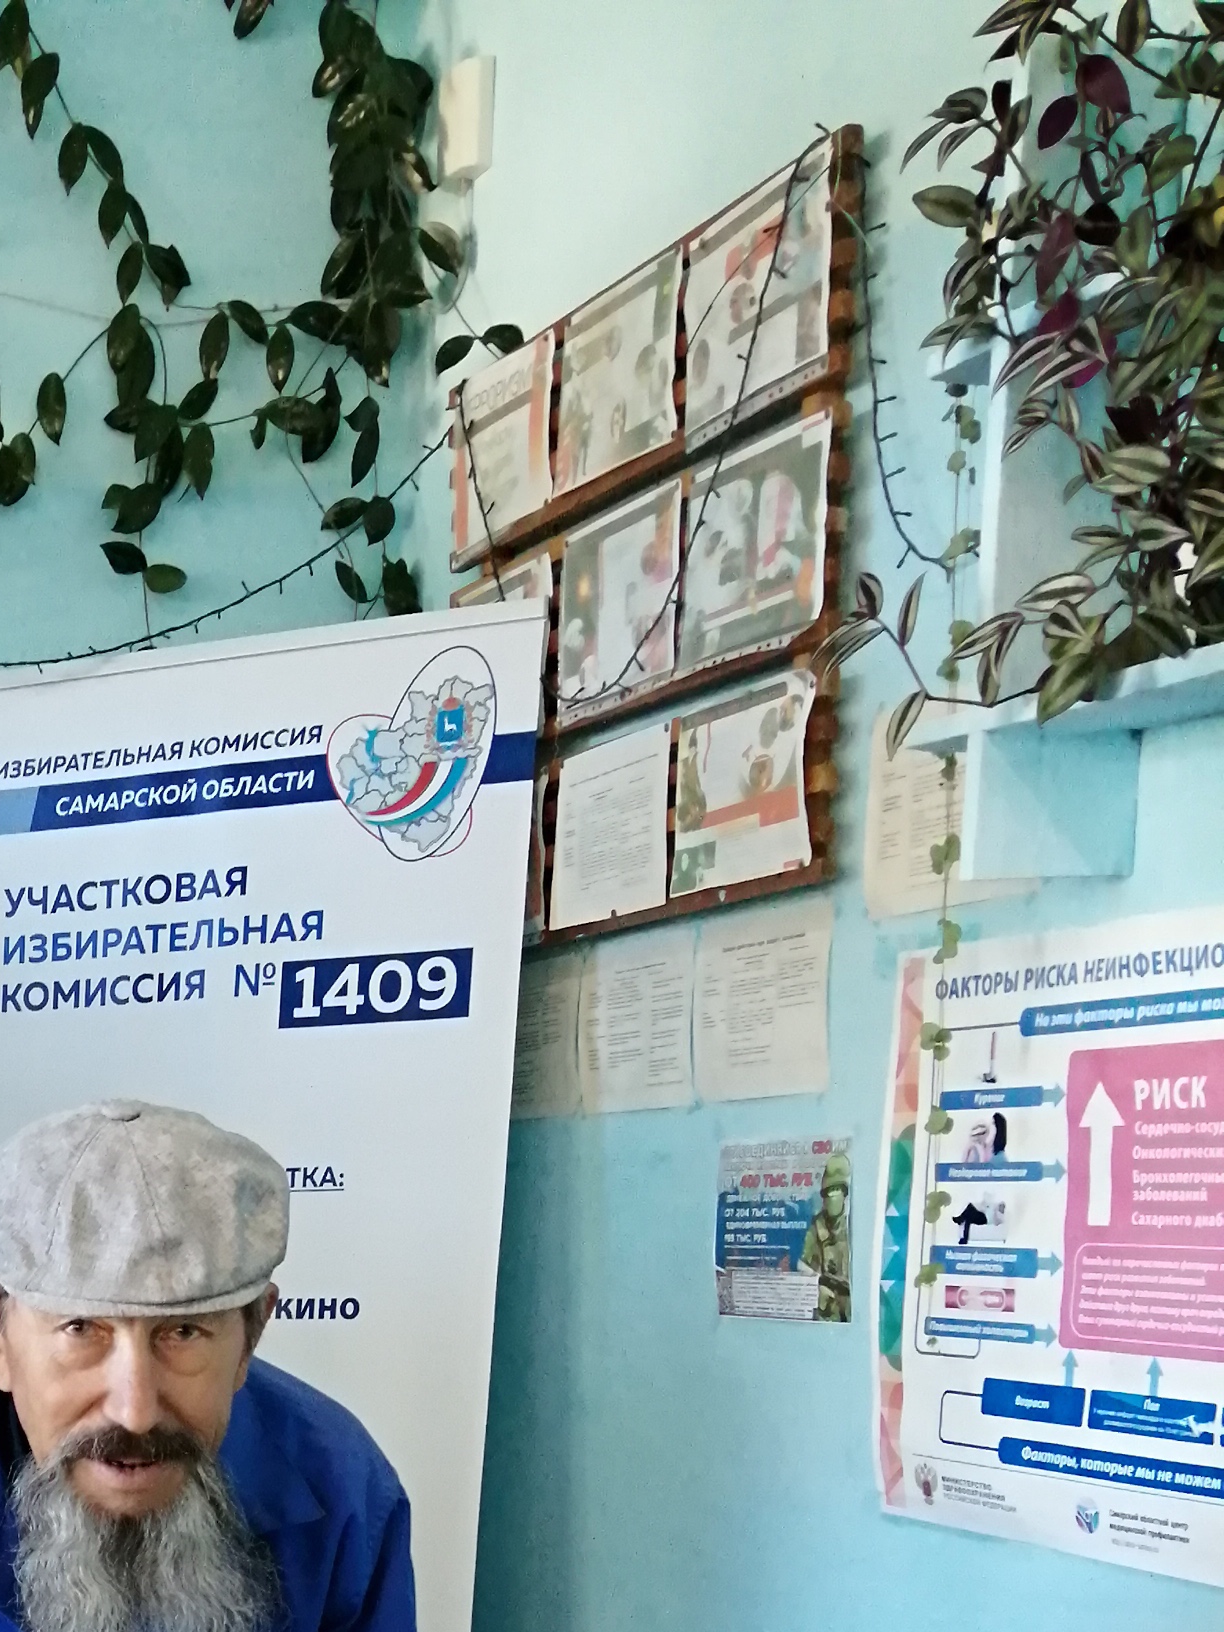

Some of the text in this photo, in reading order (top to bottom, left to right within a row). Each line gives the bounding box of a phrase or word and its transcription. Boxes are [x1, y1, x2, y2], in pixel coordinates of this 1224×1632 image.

[188, 724, 323, 759] КОМИССИЯ
[55, 769, 316, 817] САМАРСКОЙ ОБЛАСТИ
[4, 866, 248, 917] УЧАСТКОВАЯ
[2, 910, 325, 965] ИЗБИРАТЕЛЬНАЯ
[1, 955, 459, 1019] КОМИССИЯ № 1409
[935, 970, 1019, 1001] ФАКТОРЫ
[1023, 962, 1079, 992] РИСКА
[1134, 1075, 1208, 1111] РИСК
[1132, 1187, 1208, 1202] заболеваний
[1131, 1211, 1192, 1229] Сахарного
[1021, 1445, 1223, 1490] Факторы, которые мы не можем
